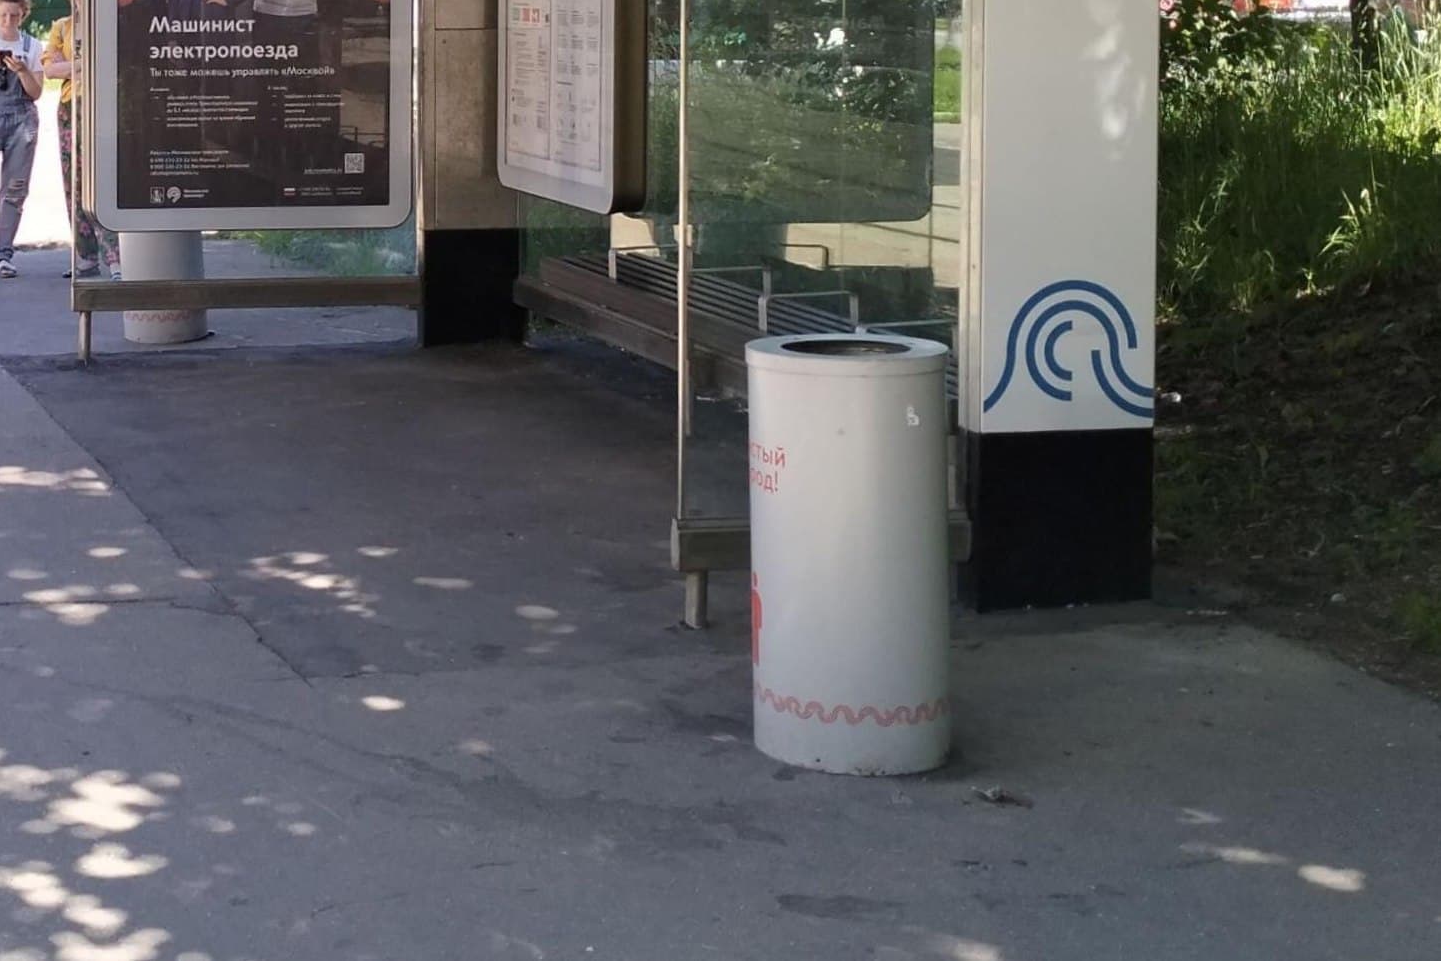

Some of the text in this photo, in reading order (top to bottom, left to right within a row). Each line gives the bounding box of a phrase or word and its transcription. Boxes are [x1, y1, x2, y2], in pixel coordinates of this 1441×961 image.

[149, 16, 255, 33] Машинист
[149, 43, 298, 61] электропоезда
[150, 67, 162, 77] Ты
[164, 69, 188, 77] тоже
[190, 69, 230, 77] можешь
[232, 68, 279, 79] управлять
